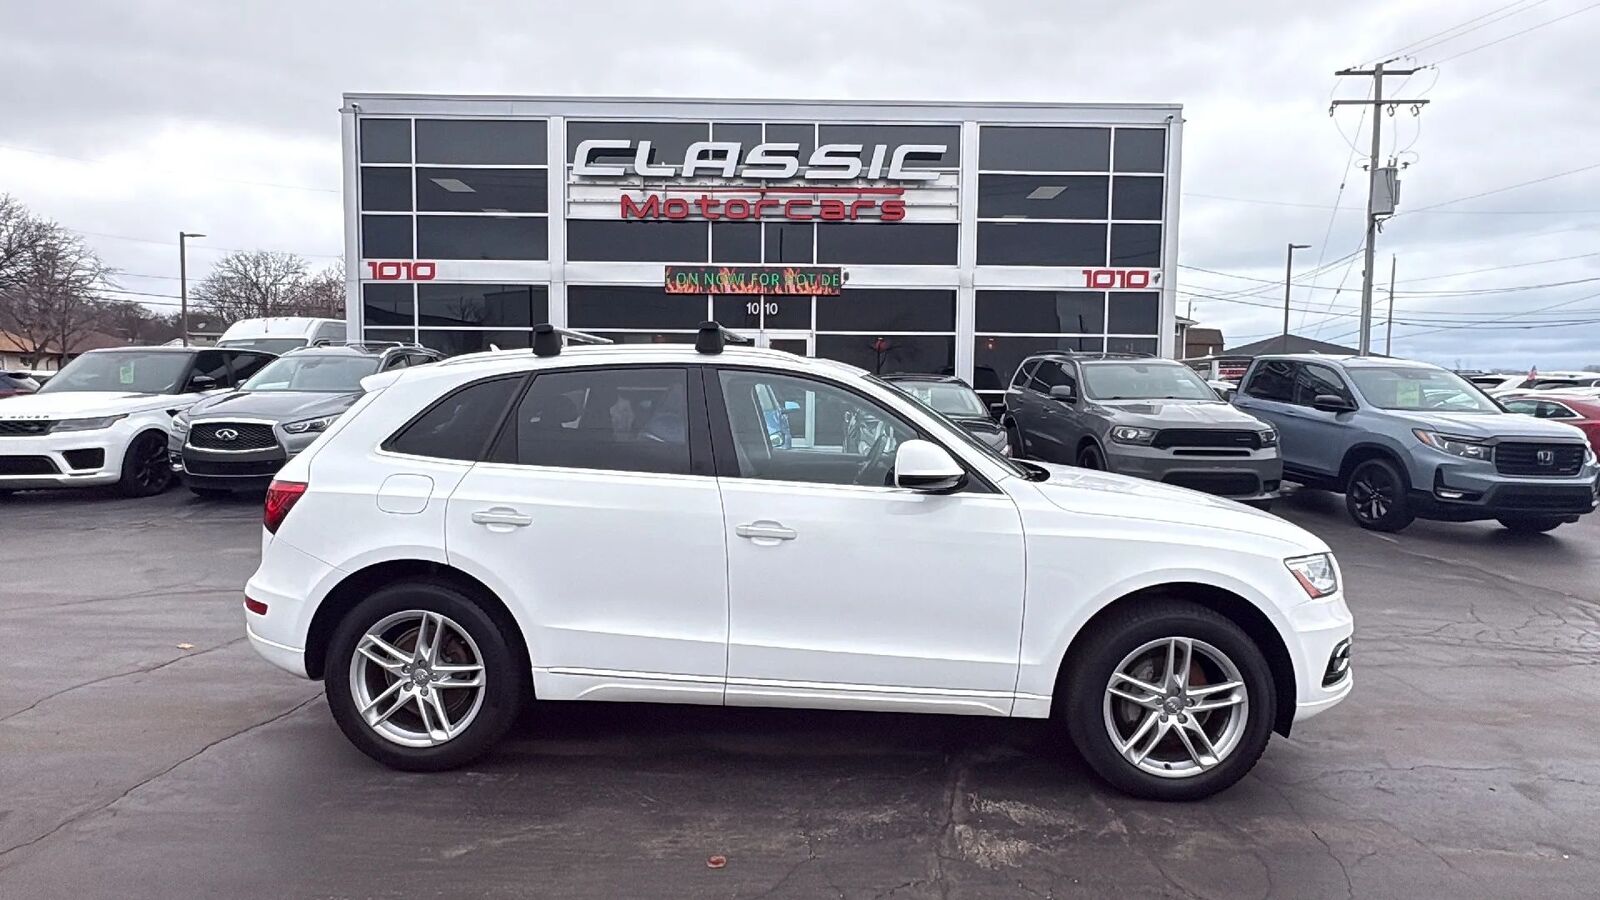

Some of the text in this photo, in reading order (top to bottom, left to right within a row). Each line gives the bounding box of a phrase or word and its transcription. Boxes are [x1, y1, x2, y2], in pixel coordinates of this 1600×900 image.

[572, 139, 948, 180] CLASSIC
[620, 194, 906, 221] Motorcars
[367, 261, 436, 281] 1010
[676, 272, 699, 285] ON
[751, 273, 780, 286] FOR
[821, 274, 840, 287] DE
[1082, 269, 1149, 289] 1010
